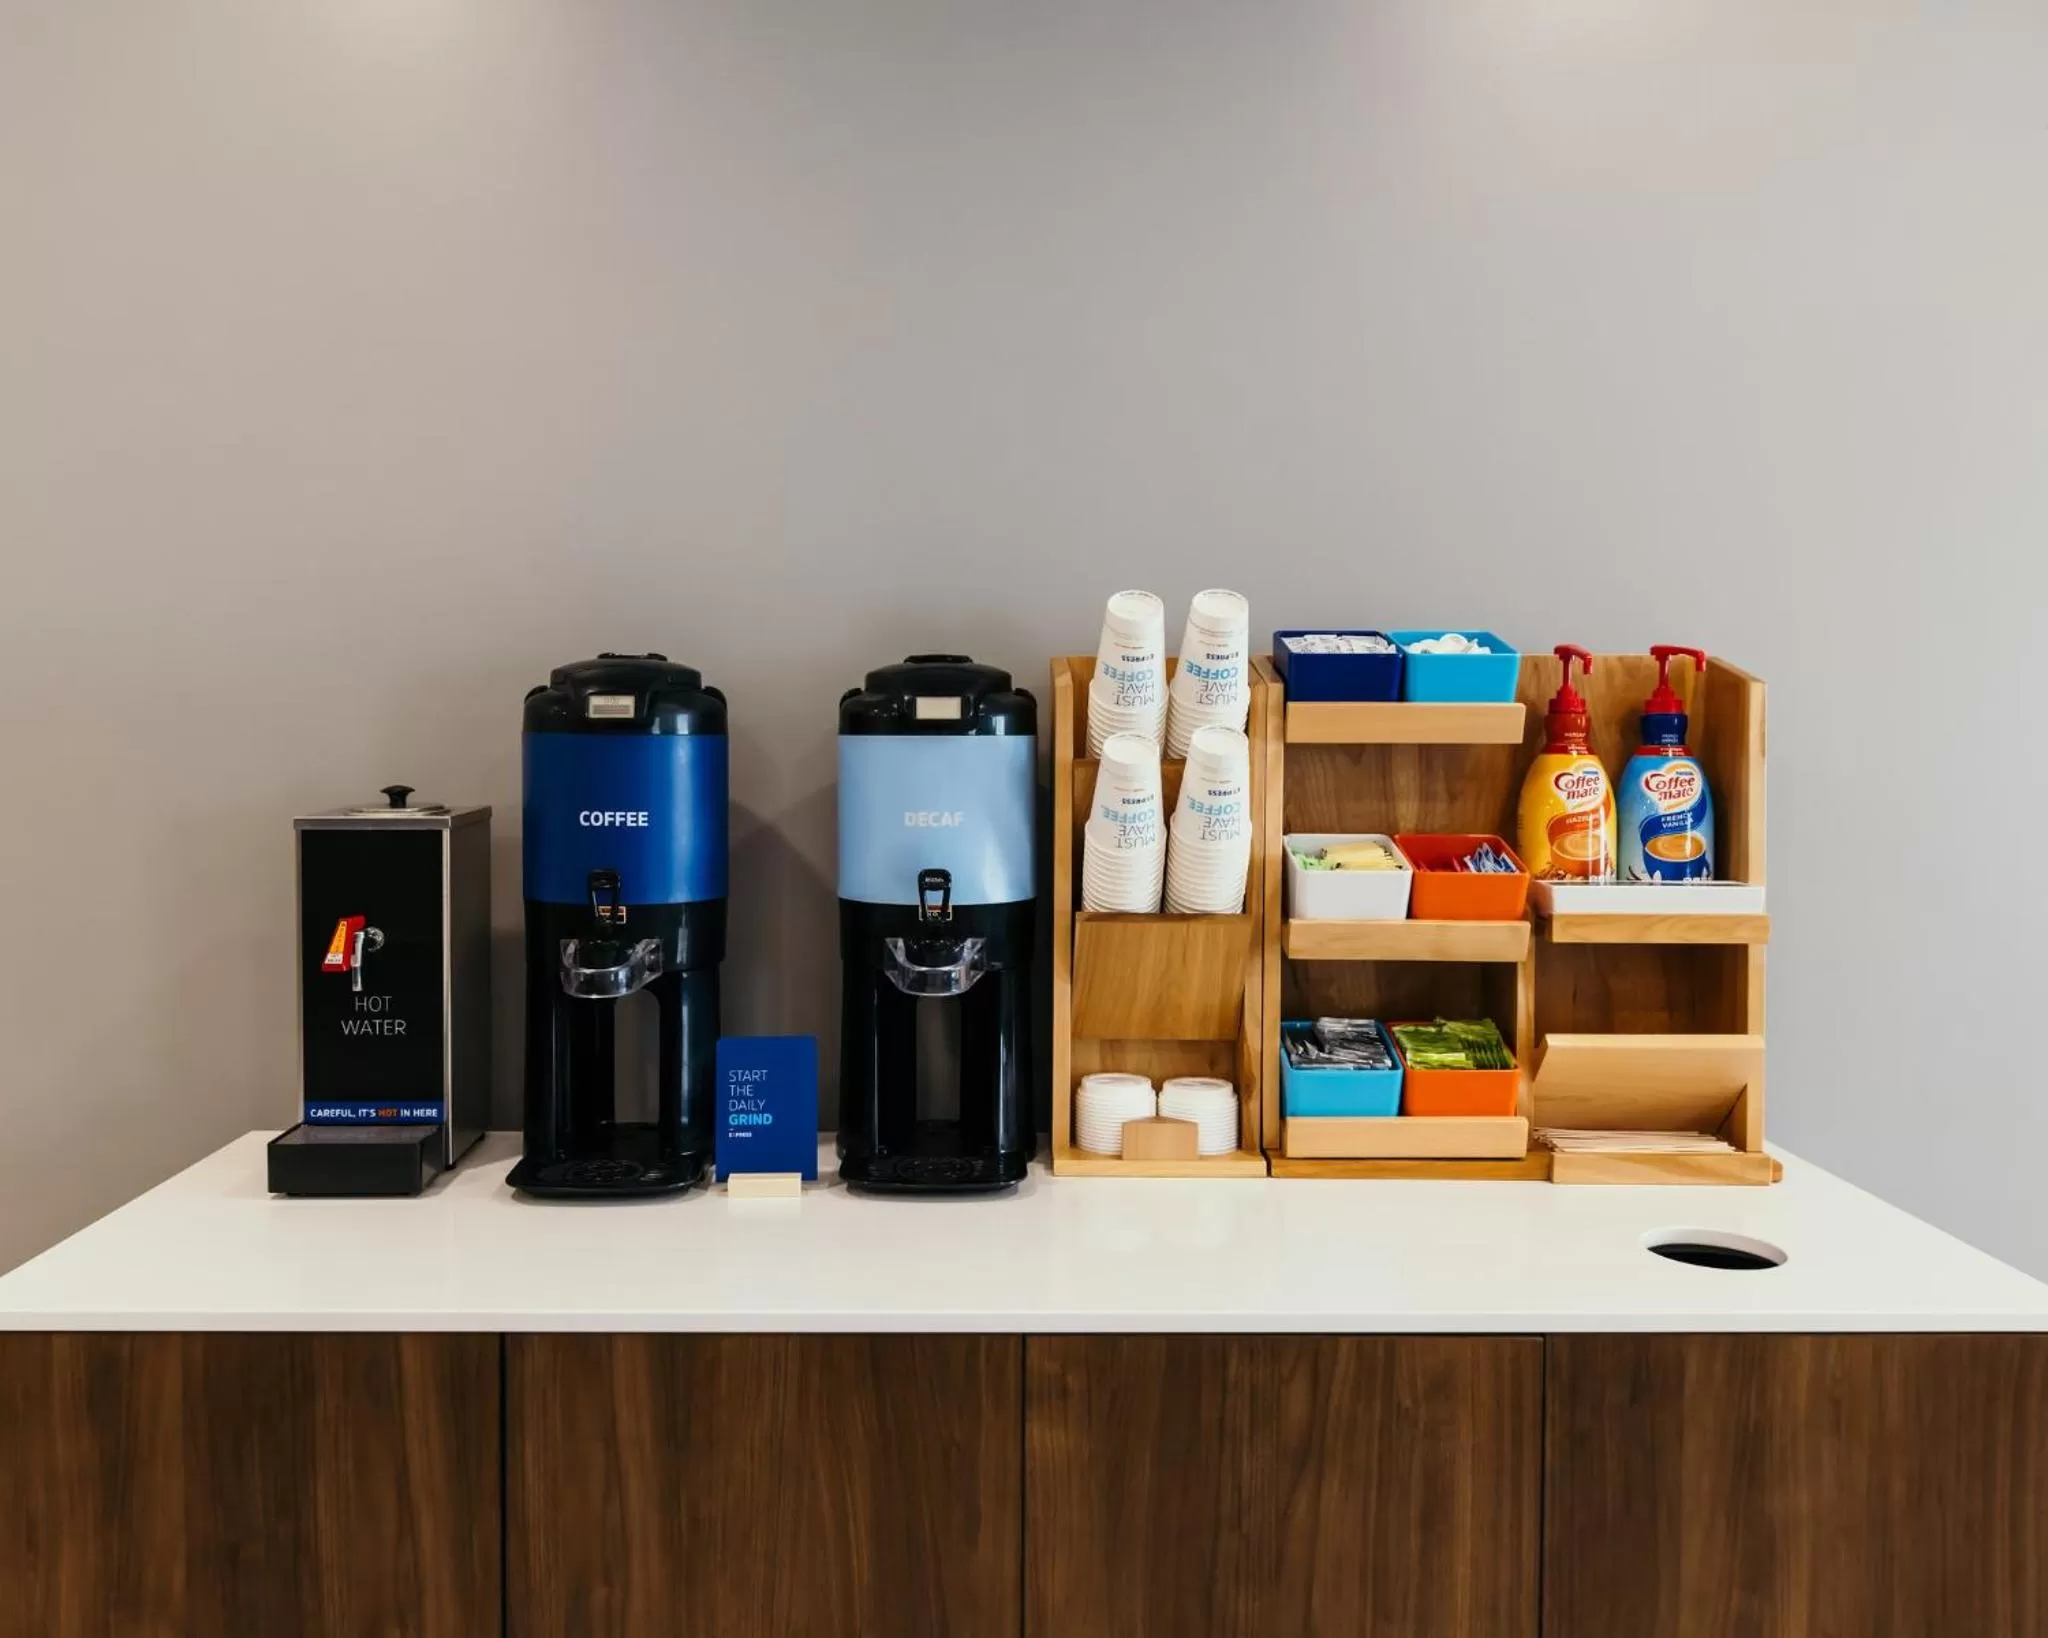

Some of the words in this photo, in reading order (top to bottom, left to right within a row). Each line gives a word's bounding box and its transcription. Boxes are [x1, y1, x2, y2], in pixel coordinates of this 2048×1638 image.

[1554, 772, 1600, 792] Coffee
[1644, 774, 1695, 792] Coffee
[1566, 787, 1600, 800] mate
[1658, 787, 1694, 801] mate
[579, 811, 649, 827] COFFEE
[904, 811, 965, 827] DECAF
[355, 996, 392, 1012] HOT
[341, 1020, 407, 1035] WATER
[728, 1070, 768, 1082] START
[728, 1084, 754, 1097] THE
[728, 1099, 766, 1111] DAILY
[310, 1108, 356, 1118] CAREFUL,
[358, 1108, 377, 1118] IT'S
[377, 1108, 398, 1118] HOT
[400, 1108, 411, 1118] IN
[413, 1108, 438, 1118] HERE
[728, 1113, 773, 1126] GRIND
